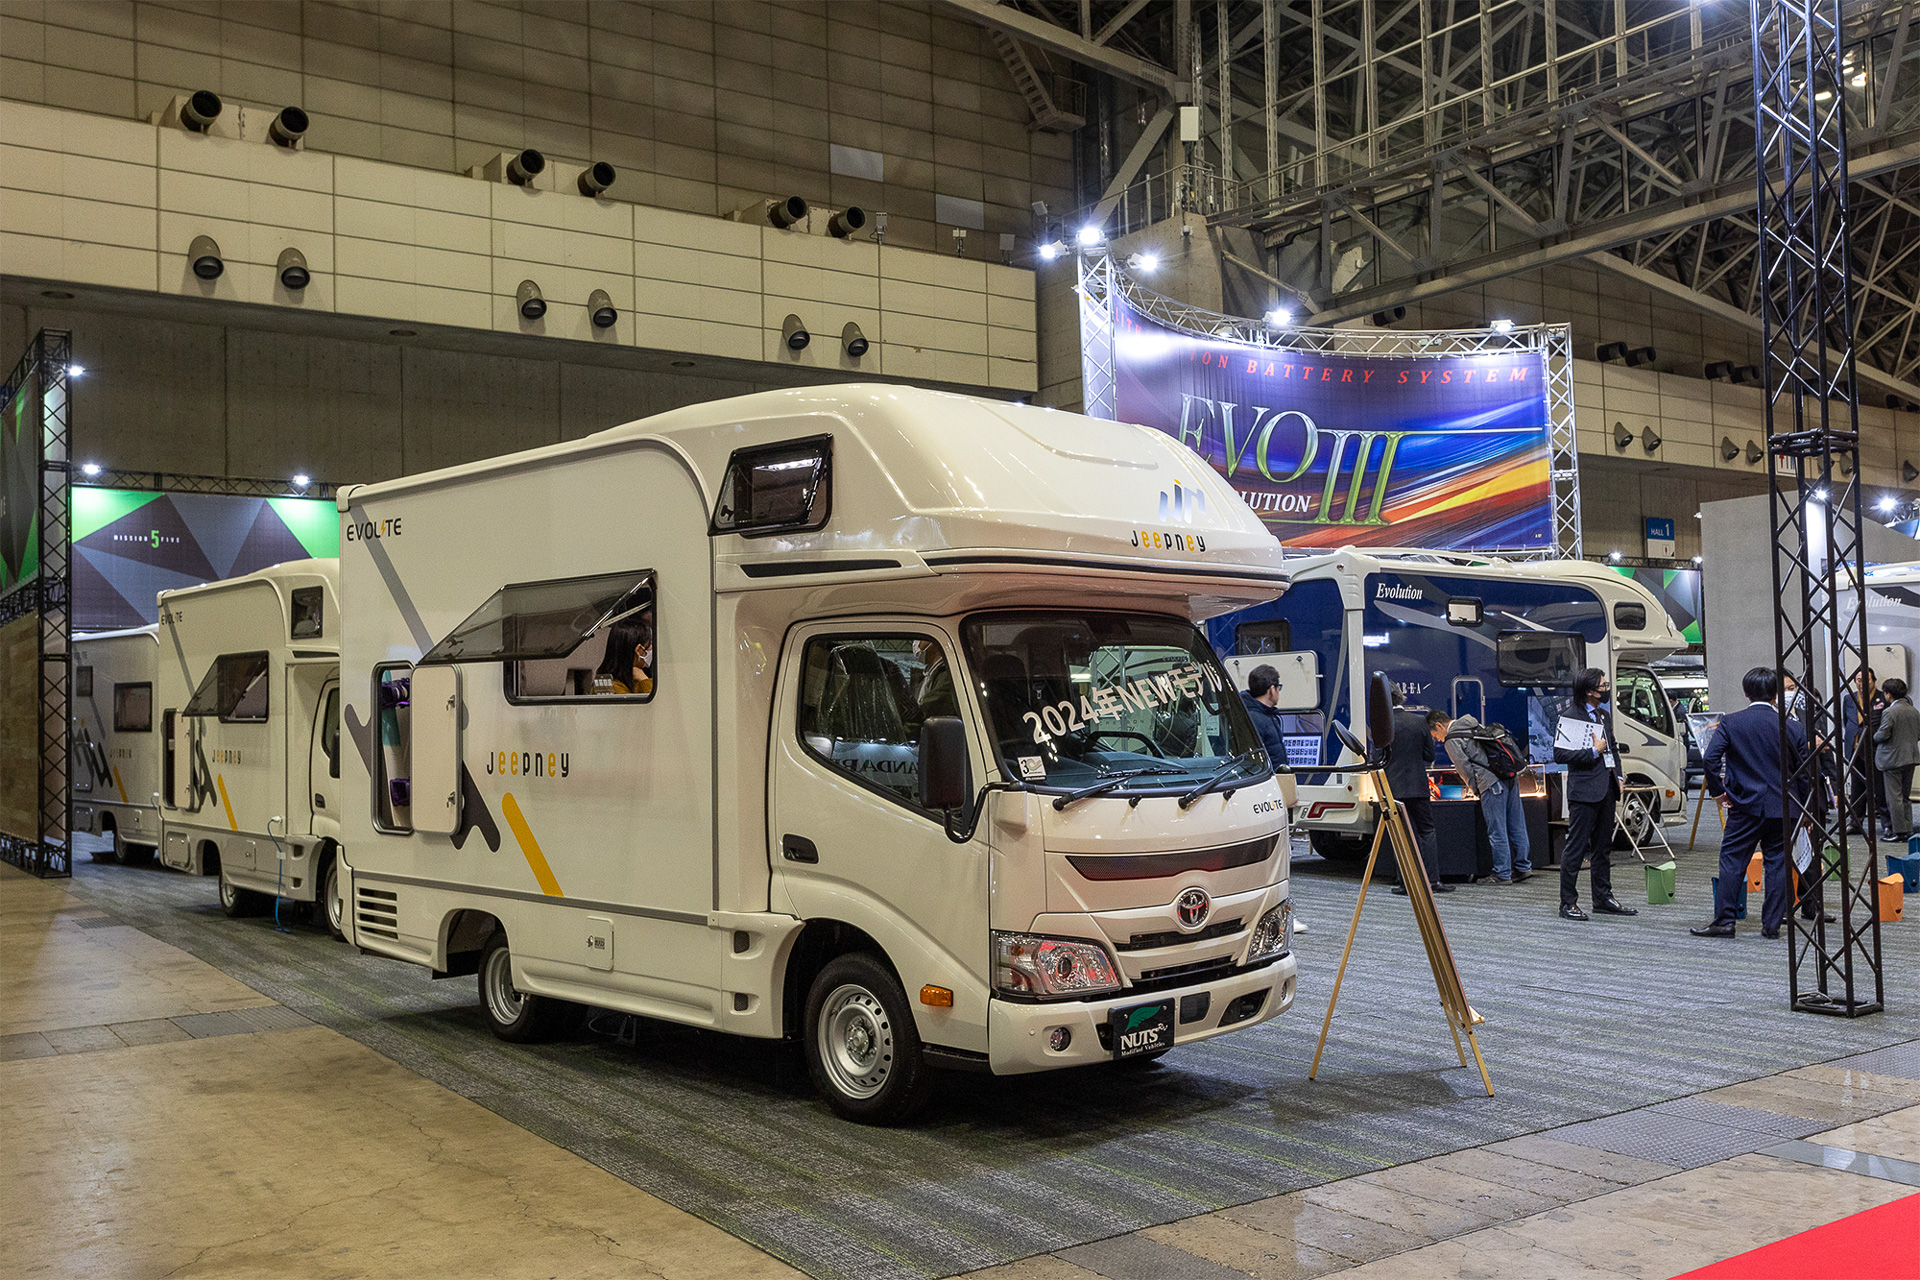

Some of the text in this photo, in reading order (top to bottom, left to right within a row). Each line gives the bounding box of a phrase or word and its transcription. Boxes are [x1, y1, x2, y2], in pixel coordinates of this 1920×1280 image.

[1246, 359, 1375, 383] BATTERY
[1397, 367, 1528, 384] SYSTEM
[150, 529, 160, 548] 5
[346, 517, 402, 541] EVOLITE
[1650, 523, 1670, 537] HALL 1
[1131, 529, 1206, 553] Jeepney
[1376, 582, 1423, 600] Evolution
[1846, 594, 1902, 610] Elution
[486, 751, 570, 778] Jeepney
[1120, 1028, 1159, 1051] NUTS
[1121, 1045, 1144, 1057] Modified
